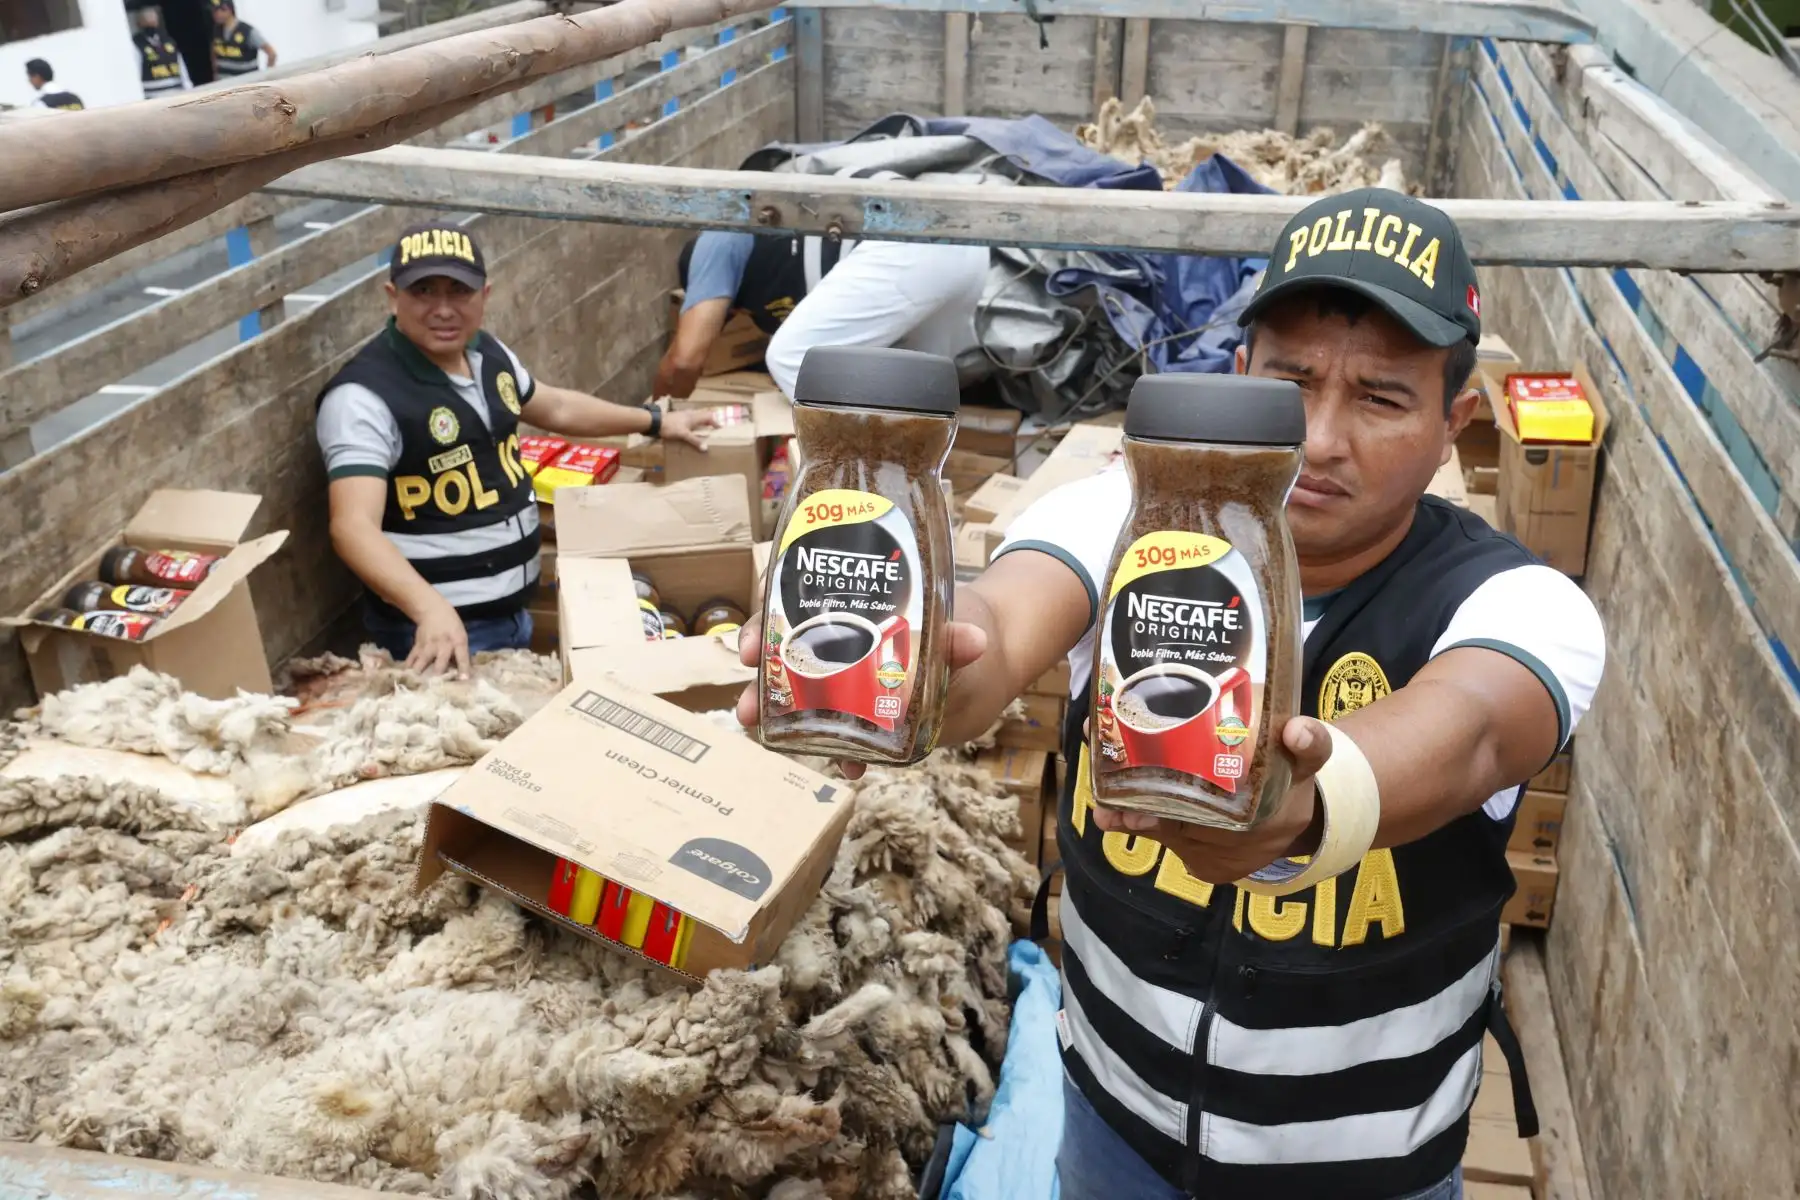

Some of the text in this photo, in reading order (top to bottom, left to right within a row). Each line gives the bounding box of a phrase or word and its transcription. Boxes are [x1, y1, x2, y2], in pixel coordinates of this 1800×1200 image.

[401, 229, 475, 265] POLICIA
[1284, 207, 1441, 290] POLICIA
[804, 502, 875, 524] 30g MÁS
[796, 546, 902, 581] NESCAFÉ
[1135, 544, 1211, 568] 30g MÁS
[803, 574, 892, 594] ORIGINAL
[799, 598, 821, 608] Doble
[850, 599, 869, 609] Más
[869, 601, 897, 612] Sabor
[1127, 592, 1241, 630] NESCAFÉ
[1134, 621, 1231, 644] ORIGINAL
[1131, 648, 1154, 658] Doble
[1185, 649, 1206, 660] Más
[1206, 651, 1237, 663] Sabor
[878, 699, 898, 709] 230
[878, 708, 898, 716] TAZAS
[493, 757, 523, 775] PACK
[604, 749, 659, 779] Clean
[1217, 757, 1240, 768] 230
[1217, 767, 1239, 776] TAZAS
[658, 775, 735, 817] Premier
[686, 848, 761, 884] Colgate
